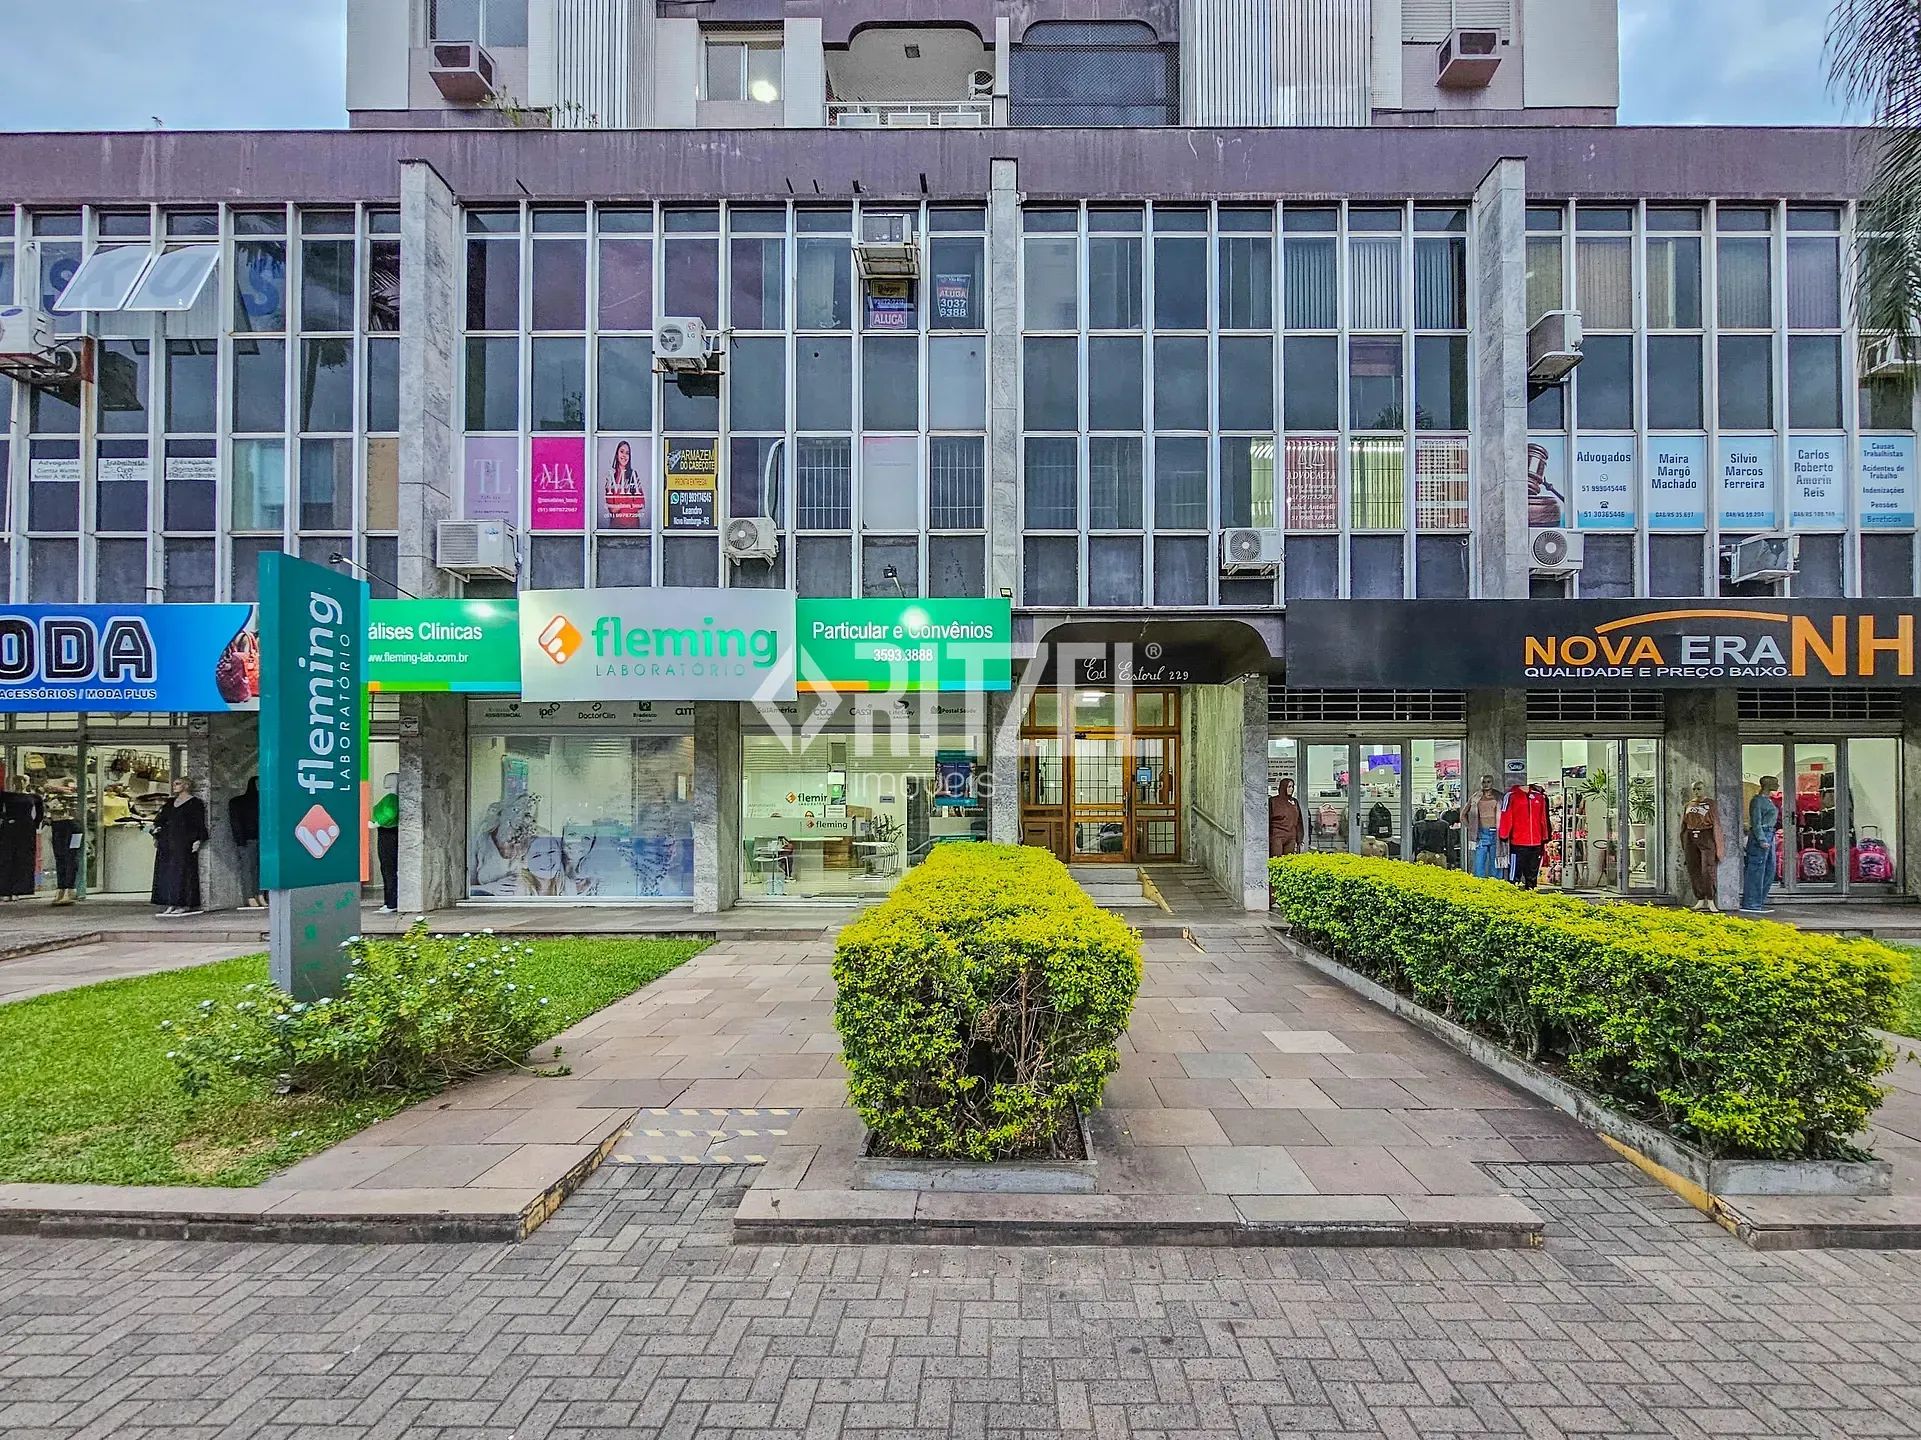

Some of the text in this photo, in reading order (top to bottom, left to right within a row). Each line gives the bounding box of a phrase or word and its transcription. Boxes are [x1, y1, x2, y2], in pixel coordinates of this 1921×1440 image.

[940, 298, 967, 308] 3037
[940, 308, 967, 317] 9388
[874, 313, 904, 325] ALUGA
[1577, 452, 1631, 464] Advogados
[1659, 454, 1689, 463] Maira
[1730, 453, 1757, 463] Silvio
[1798, 449, 1829, 459] Carlos
[1657, 466, 1691, 479] Margô
[1725, 466, 1763, 476] Marcos
[1794, 462, 1833, 472] Roberto
[1651, 479, 1697, 489] Machado
[1724, 479, 1765, 489] Ferreira
[1803, 487, 1825, 498] Reis
[682, 506, 703, 515] Leandro
[418, 622, 483, 640] Clínicas
[812, 621, 993, 640] Particular e Convênios
[591, 616, 778, 669] fleming
[1525, 615, 1914, 677] NOVA ERA NH
[0, 615, 157, 684] ODA
[873, 648, 934, 662] 3593.3888
[596, 662, 746, 677] LABORATÓRIO
[1525, 667, 1634, 677] QUALIDADE
[1638, 667, 1651, 677] E
[1656, 667, 1724, 679] PREÇO
[1168, 671, 1189, 680] 229
[86, 689, 121, 699] MODA
[125, 689, 156, 699] PLUS
[298, 591, 343, 795] fleming
[339, 634, 351, 791] LABORATÓRIO
[816, 821, 847, 829] fleming
